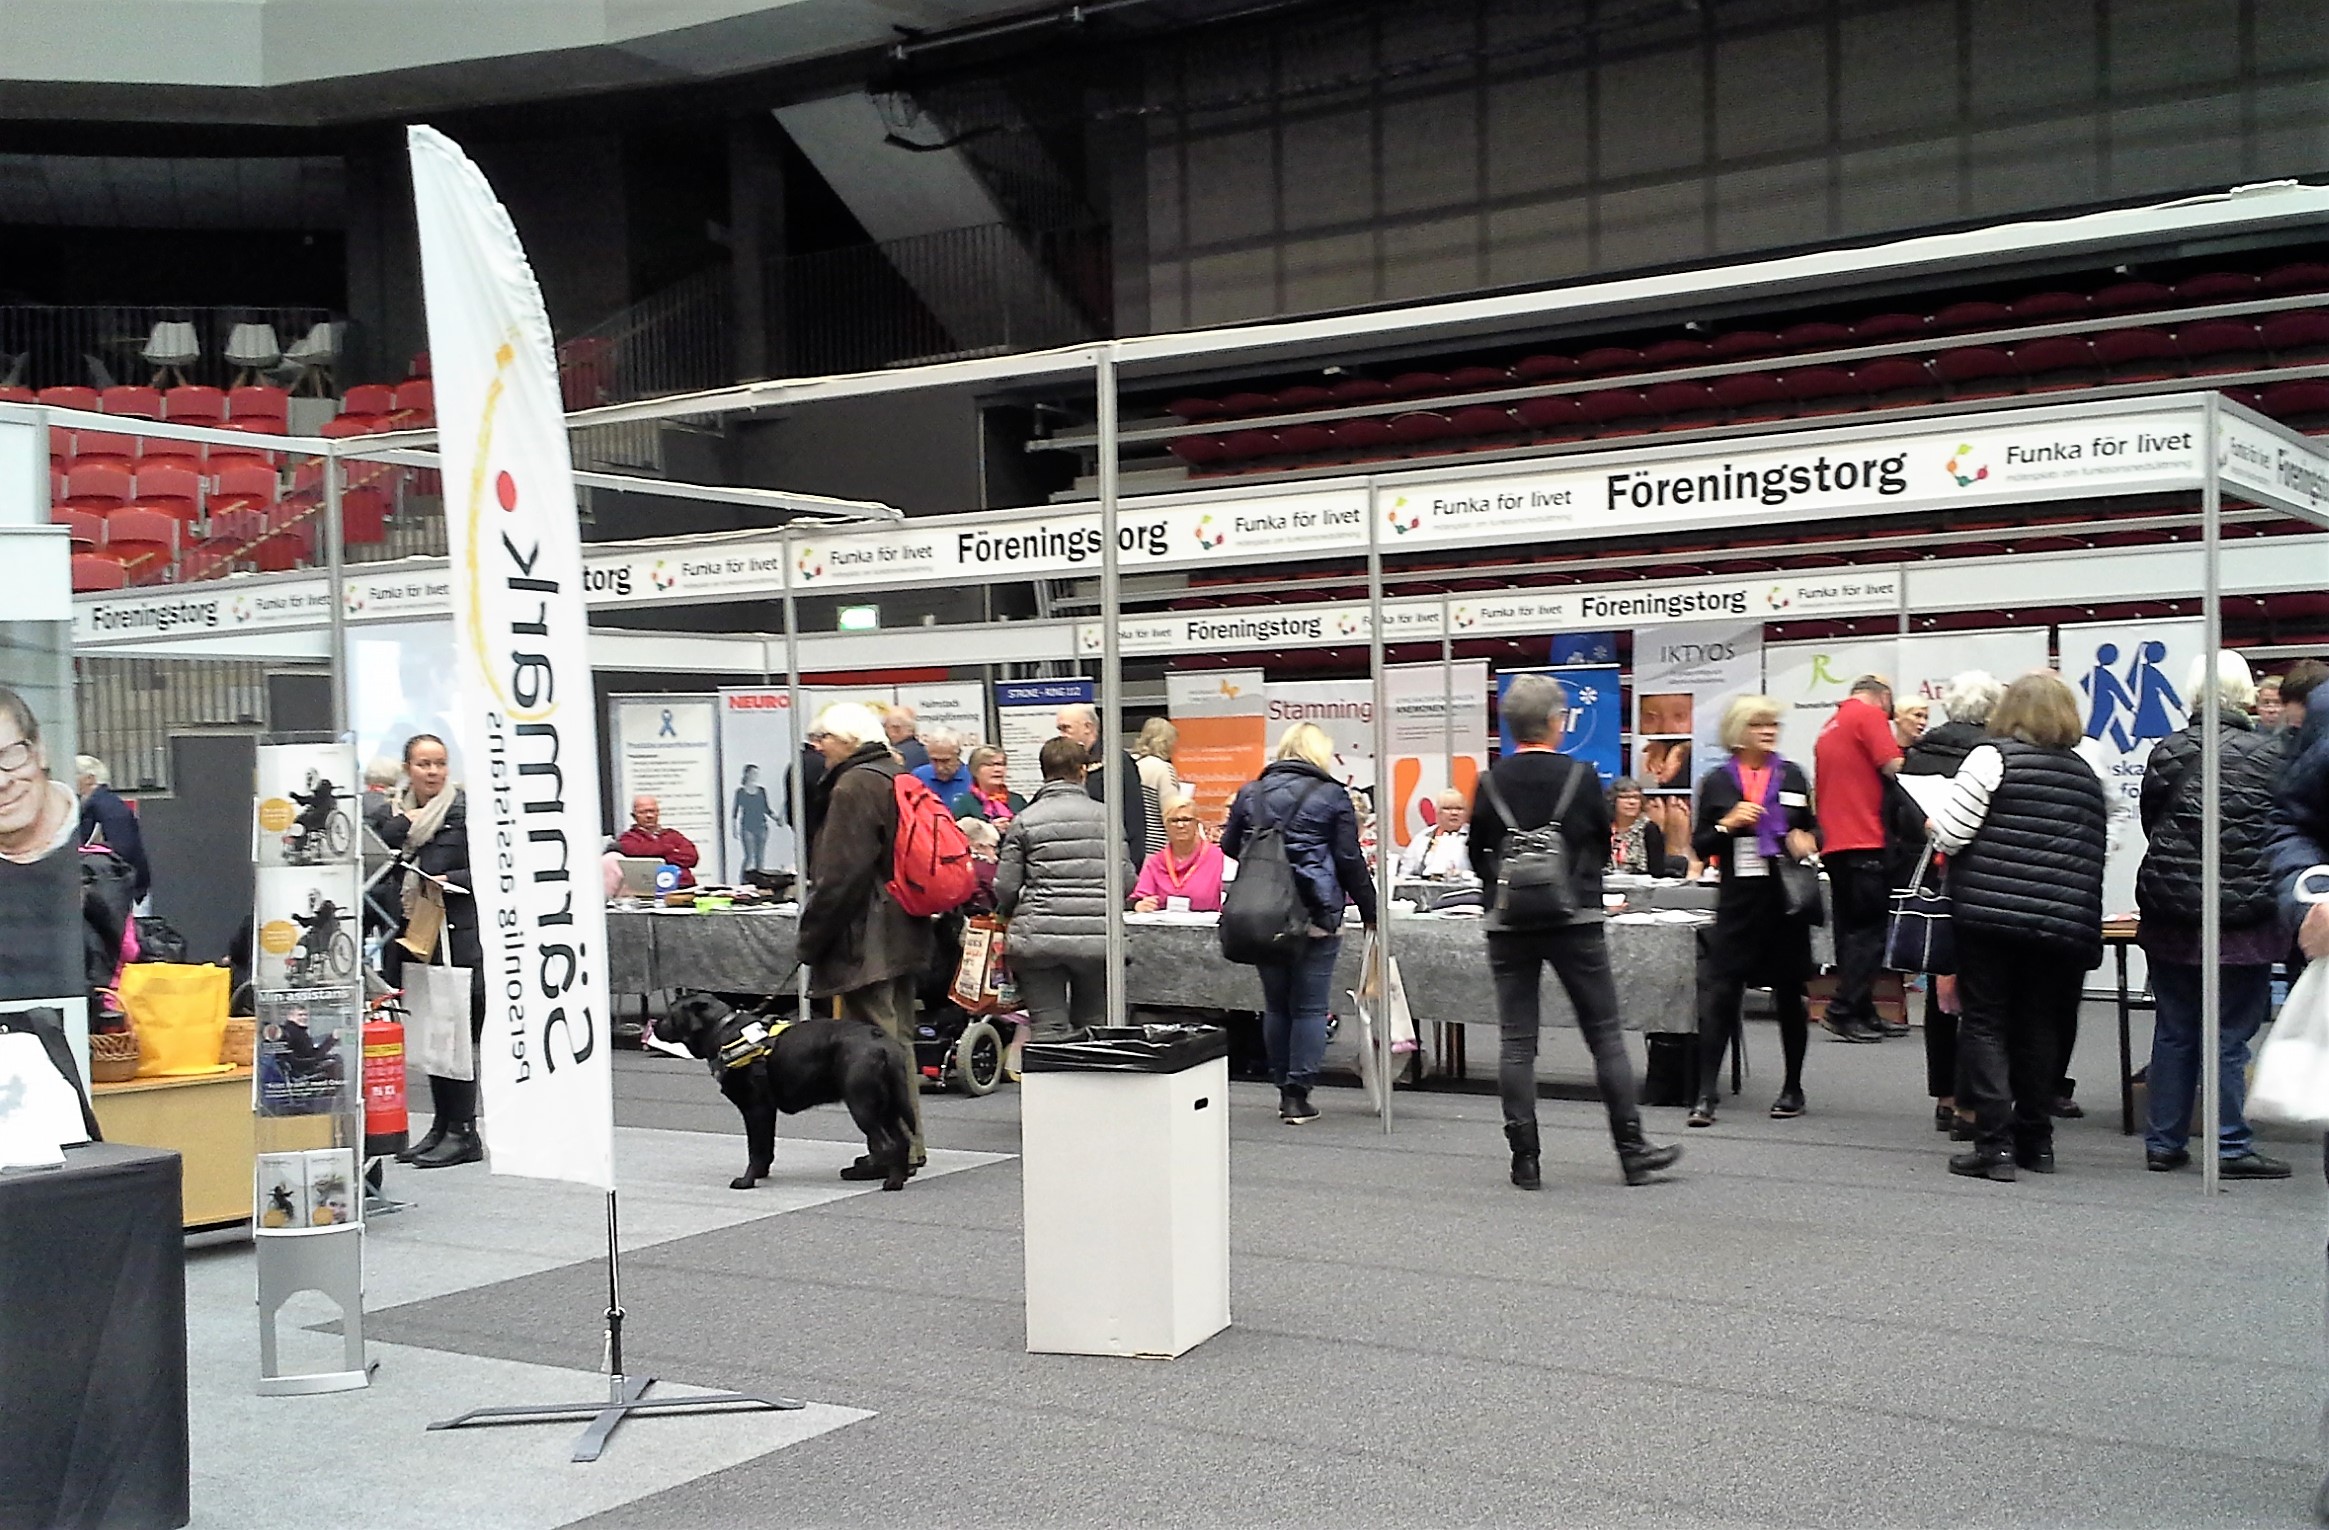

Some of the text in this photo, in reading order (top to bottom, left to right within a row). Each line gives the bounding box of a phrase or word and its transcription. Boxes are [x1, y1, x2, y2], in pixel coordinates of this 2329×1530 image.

[2006, 432, 2193, 465] Funka för livet
[1606, 451, 1908, 511] Föreningstorg
[1432, 488, 1572, 516] Funka för livet
[1234, 508, 1361, 534] Funka för livet
[830, 543, 934, 565] Funka för livet
[957, 520, 1169, 564] Föreningsorg
[681, 556, 778, 577] Funka för livet
[91, 599, 220, 632] Föreningstorg
[1580, 589, 1748, 618] Föreningstorg
[1187, 614, 1322, 643] Föreningstorg
[1660, 642, 1736, 664] IKTYOS
[1268, 697, 1374, 723] Stamning
